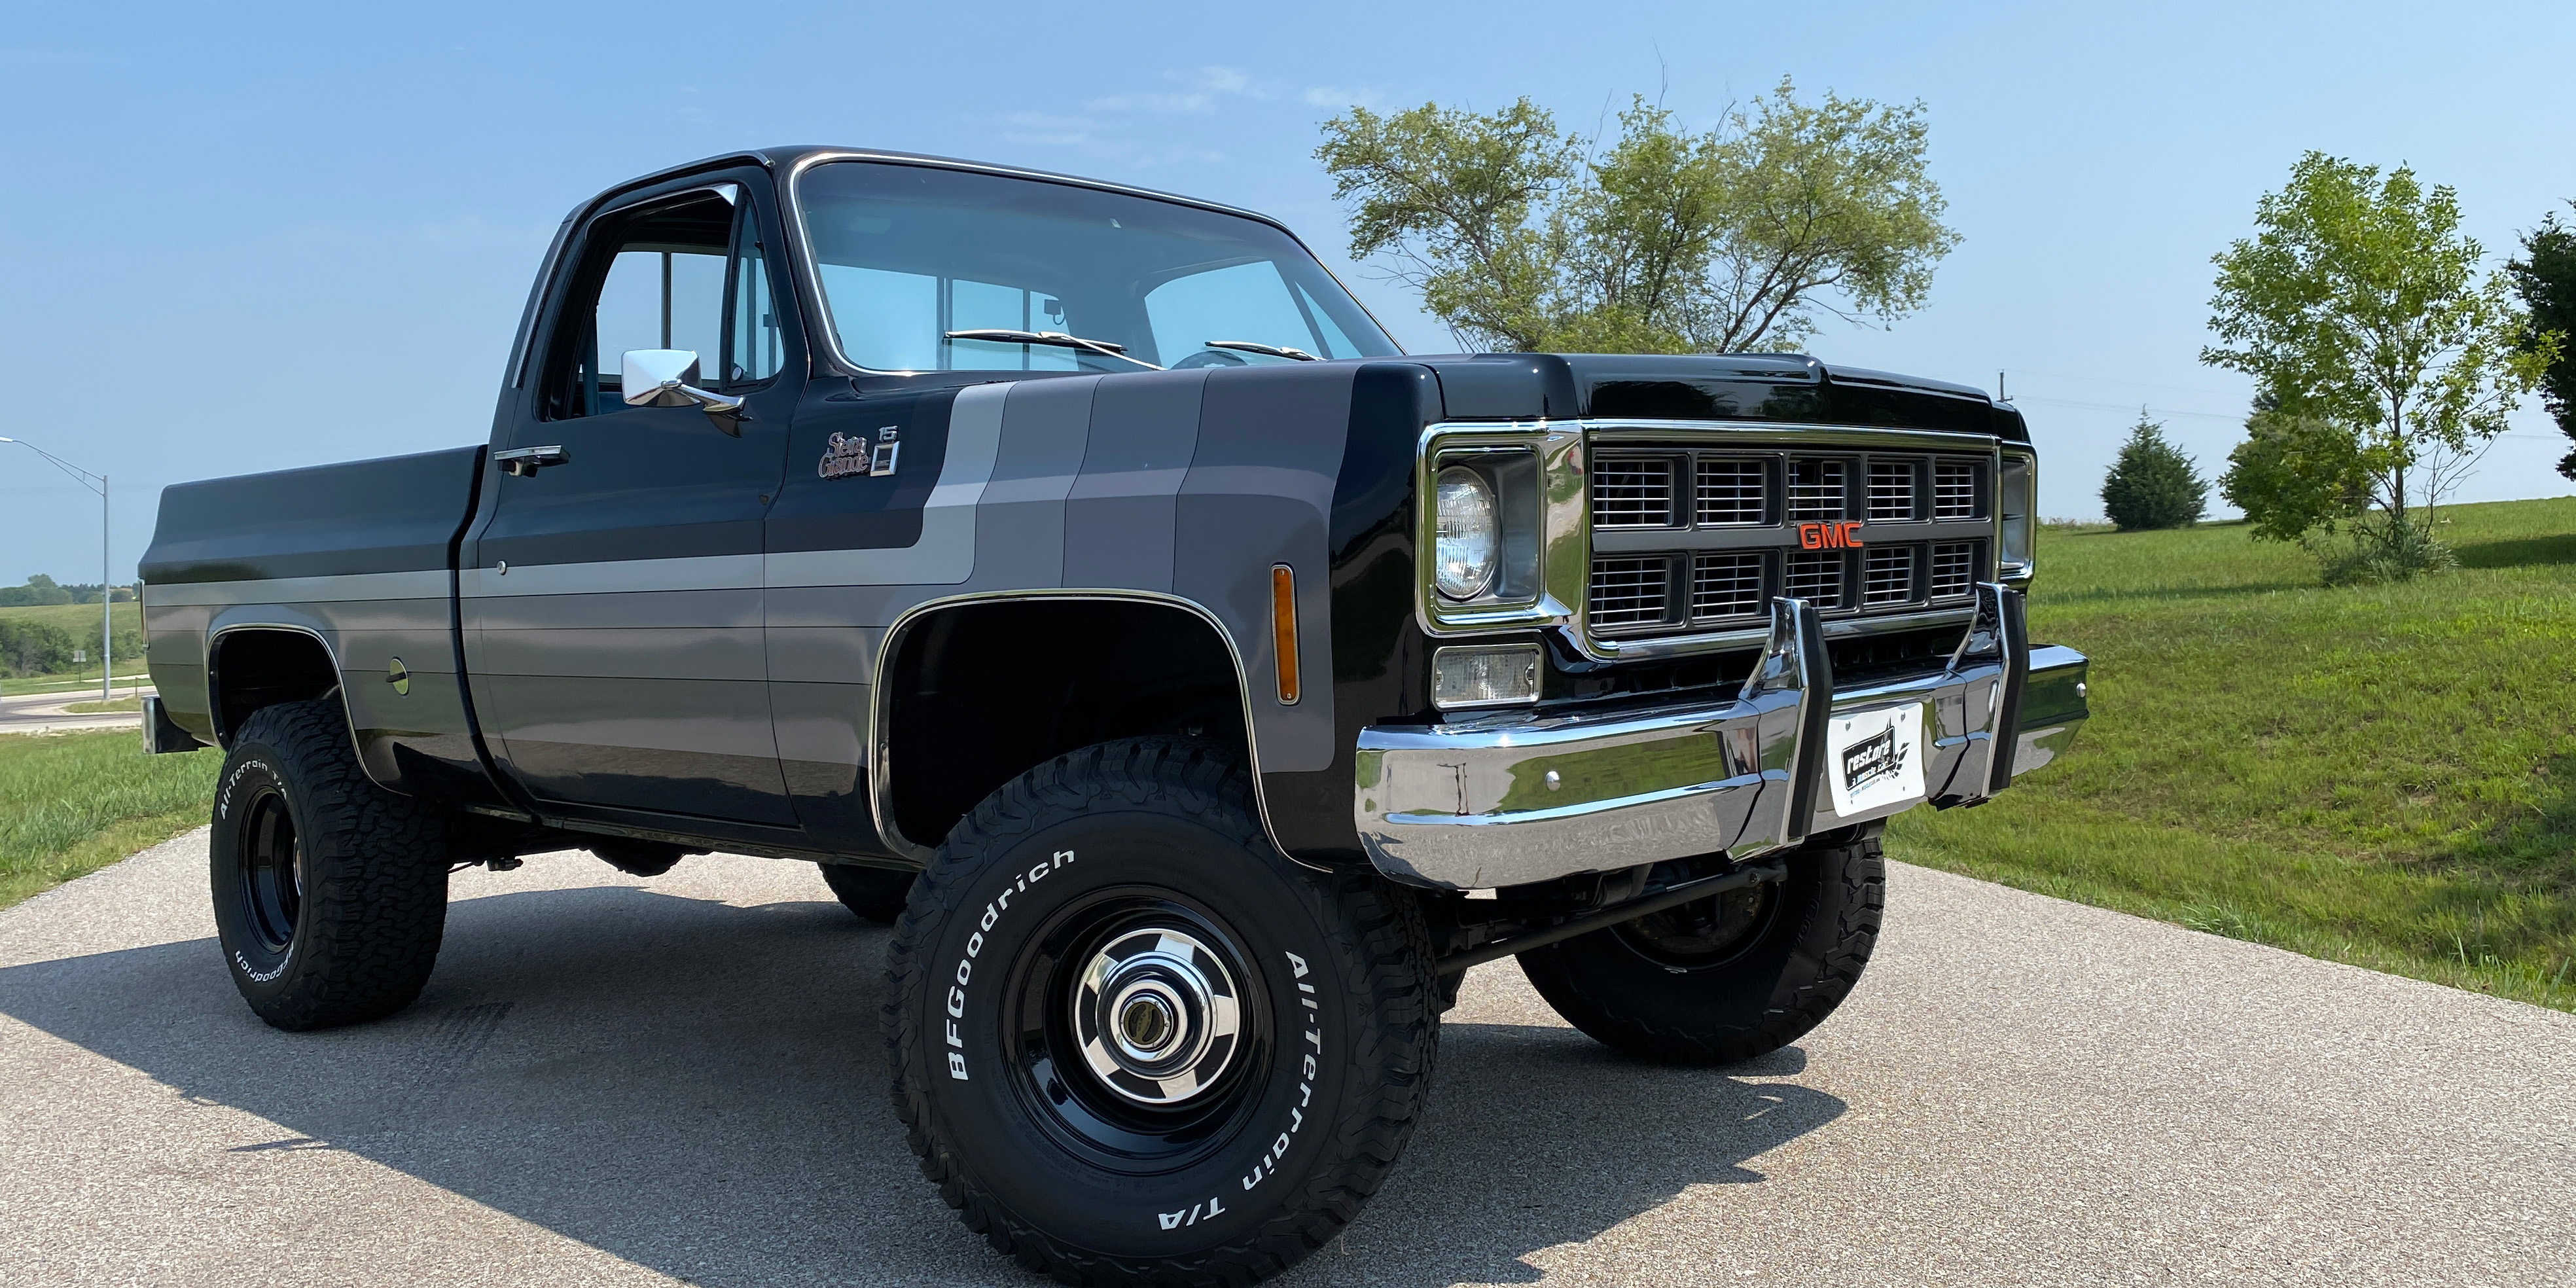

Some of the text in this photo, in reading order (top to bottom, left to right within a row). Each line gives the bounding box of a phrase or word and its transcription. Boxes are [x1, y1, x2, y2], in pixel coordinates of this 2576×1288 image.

[829, 431, 867, 457] Sierra
[878, 425, 898, 442] 15
[818, 448, 869, 478] Grande
[1797, 522, 1864, 549] GMC
[1847, 740, 1891, 774] restore
[221, 759, 268, 819] All-Terrain
[1857, 766, 1876, 784] muscle
[236, 940, 293, 982] BFGoodrich
[946, 850, 1075, 1080] BFGoodrich
[1158, 951, 1321, 1230] All-Terrain T/A
